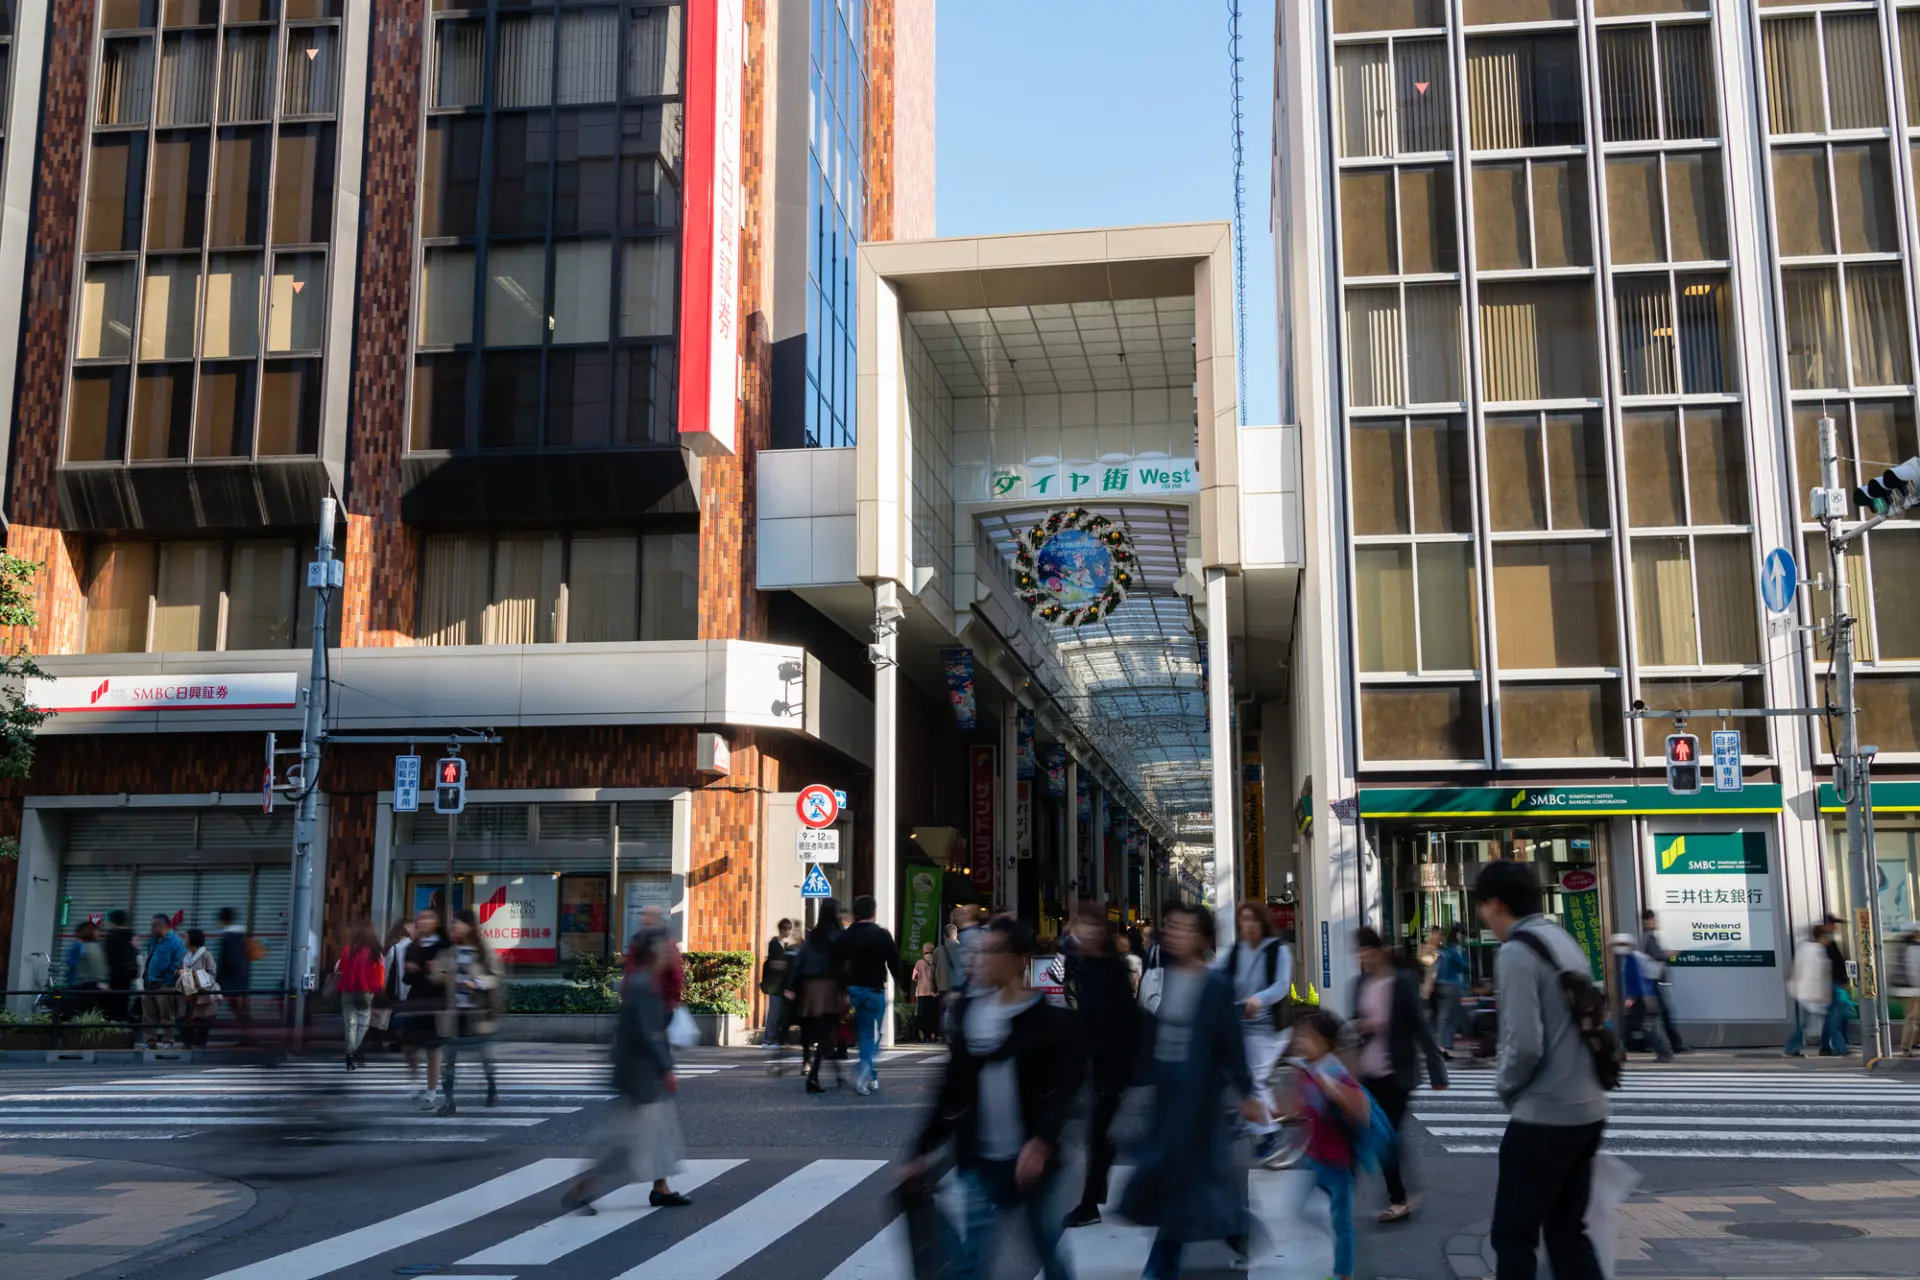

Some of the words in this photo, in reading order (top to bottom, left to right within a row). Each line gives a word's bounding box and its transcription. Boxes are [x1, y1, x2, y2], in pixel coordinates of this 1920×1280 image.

[992, 468, 1129, 497] ダイヤ街
[1139, 468, 1191, 485] West
[132, 685, 229, 701] SMBC日興証券
[1715, 736, 1726, 765] 自転車
[1726, 736, 1737, 766] 歩行者
[398, 760, 408, 787] 自転車
[408, 761, 417, 788] 歩行者
[1723, 767, 1733, 787] 専用
[401, 788, 411, 807] 専用
[1530, 794, 1566, 805] SMBC
[1688, 860, 1716, 869] SMBC
[510, 899, 536, 907] SMBC
[1665, 889, 1762, 904] 三井住友銀行
[1692, 932, 1742, 941] SMBC
